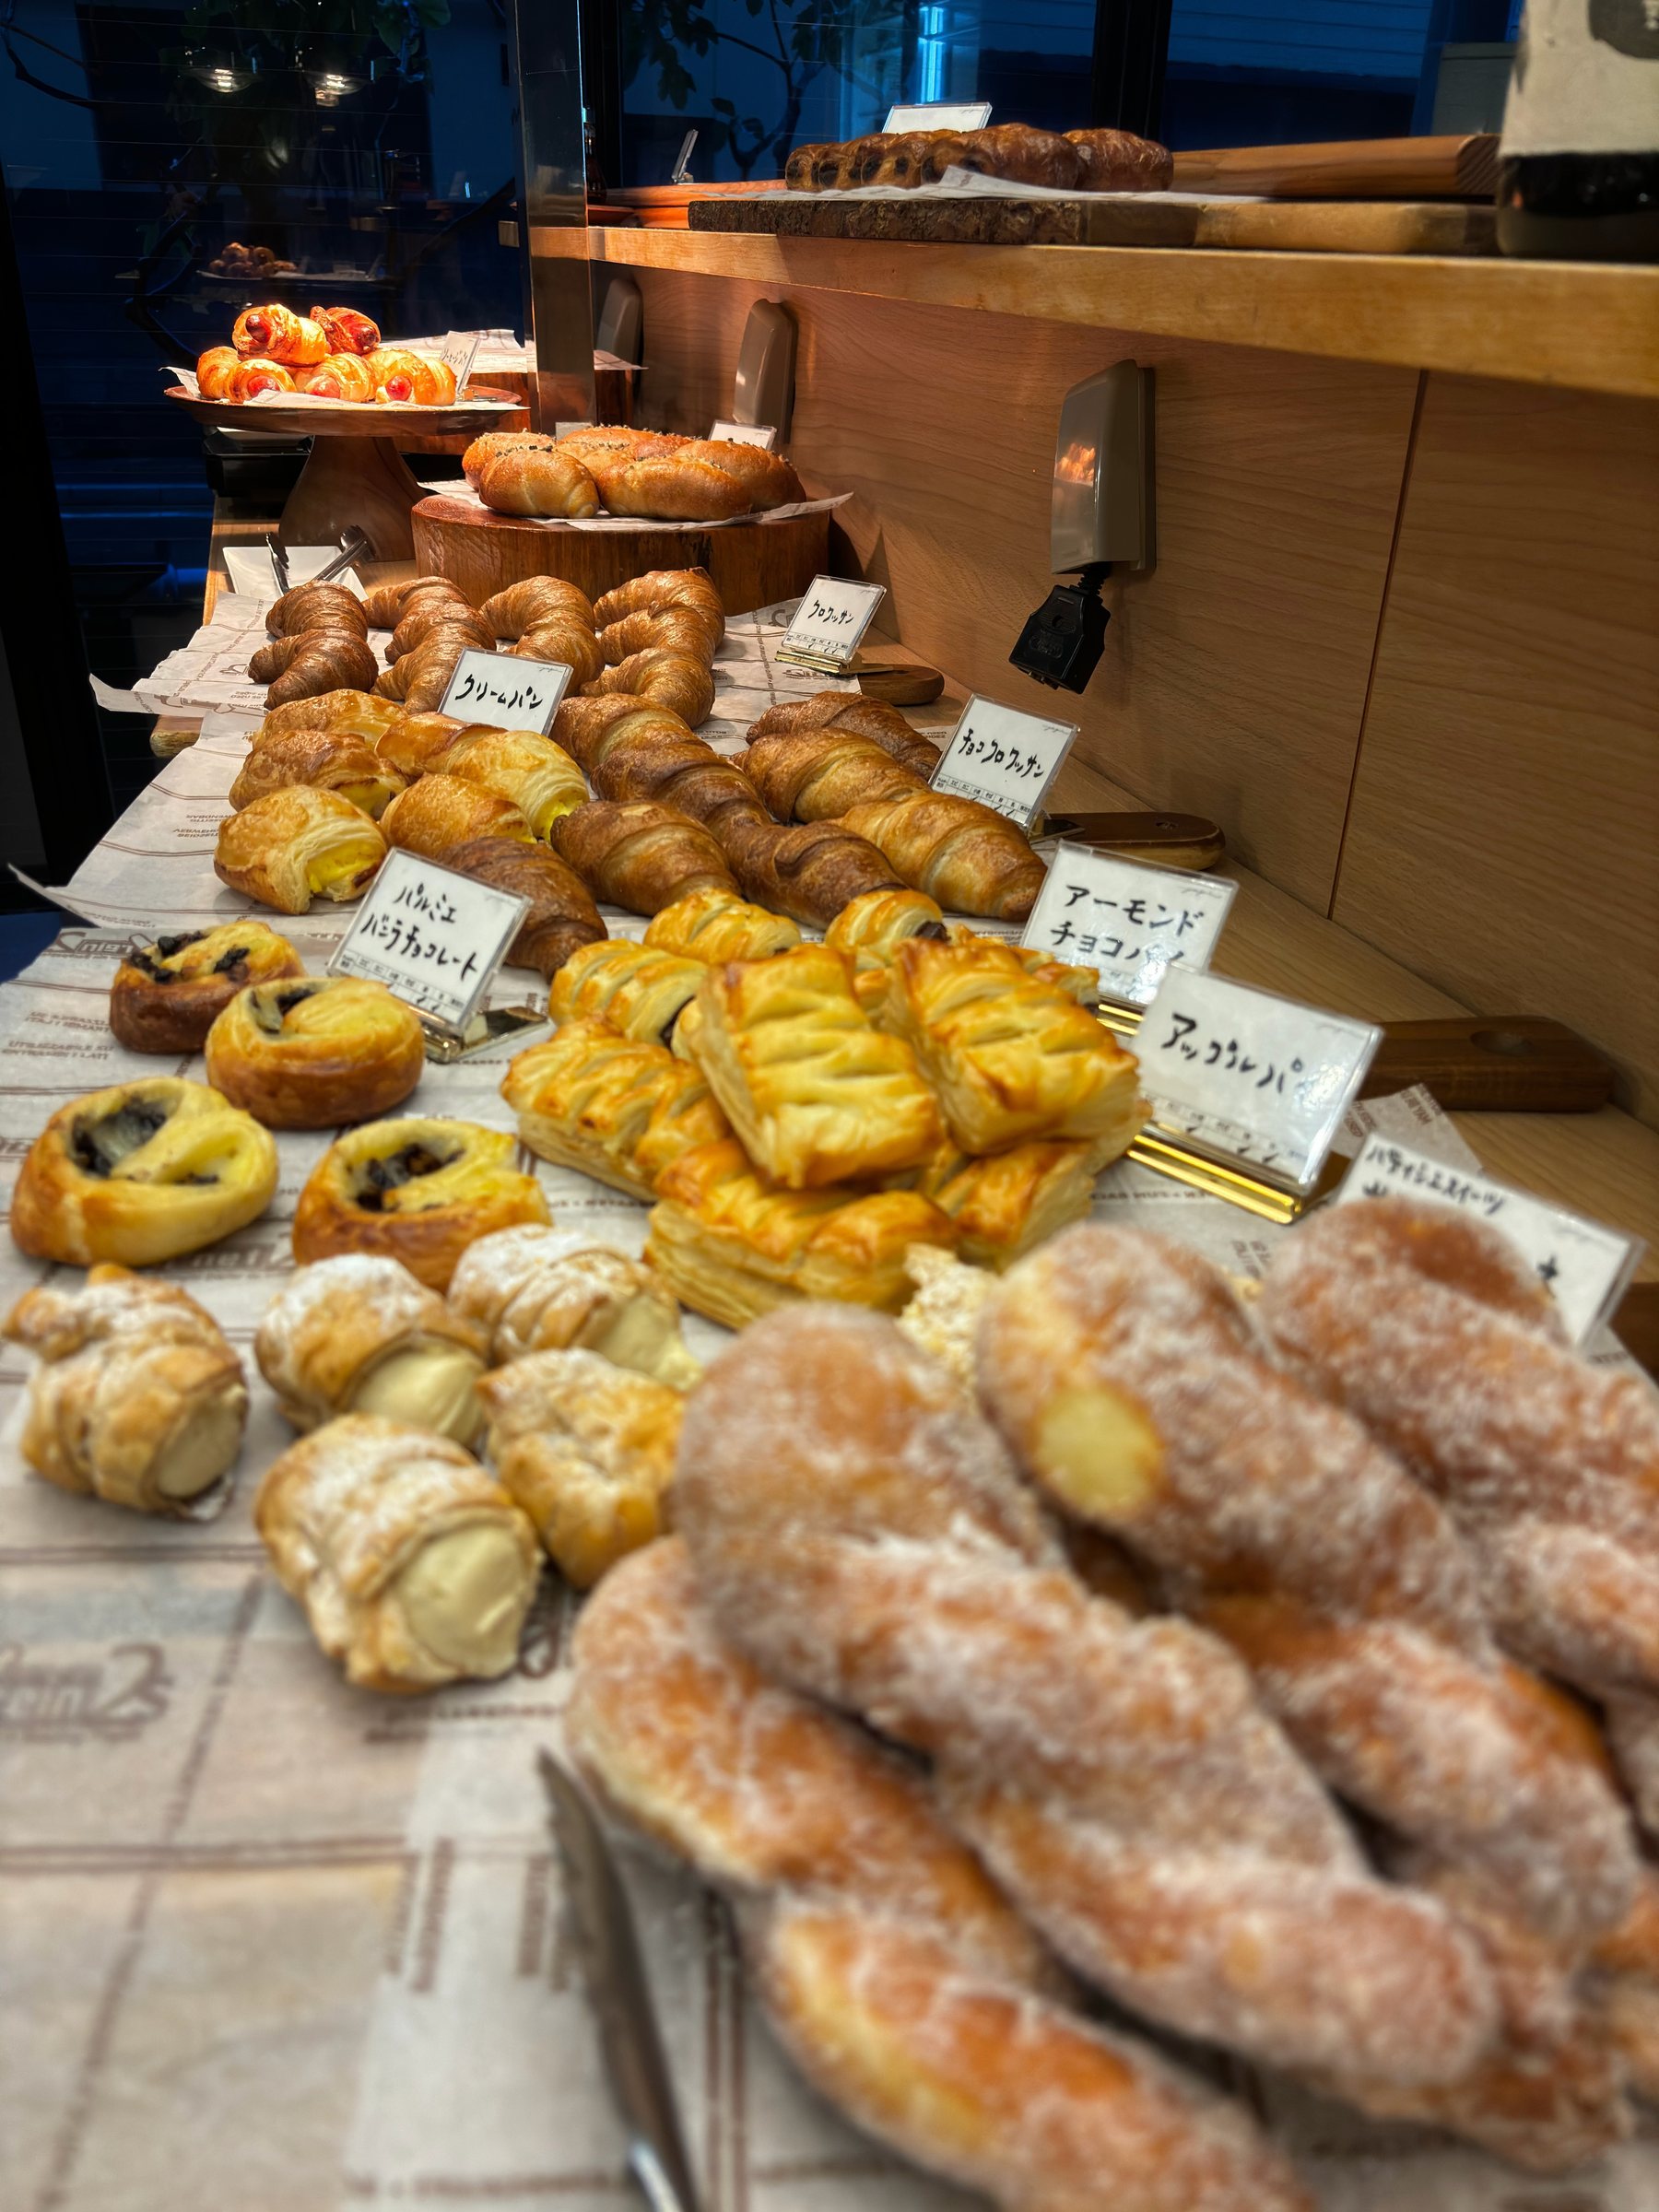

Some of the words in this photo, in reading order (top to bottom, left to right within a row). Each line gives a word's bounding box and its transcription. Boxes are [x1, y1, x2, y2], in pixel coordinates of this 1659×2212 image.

[807, 599, 854, 625] クロワッサン
[454, 673, 544, 710] クリームパン
[958, 727, 1044, 779] チョコクロワッサン
[393, 882, 457, 924] パルミエ
[1065, 884, 1205, 936] アーモンド
[359, 913, 478, 982] バニラチョコレート
[1160, 1013, 1305, 1094] アップルパ
